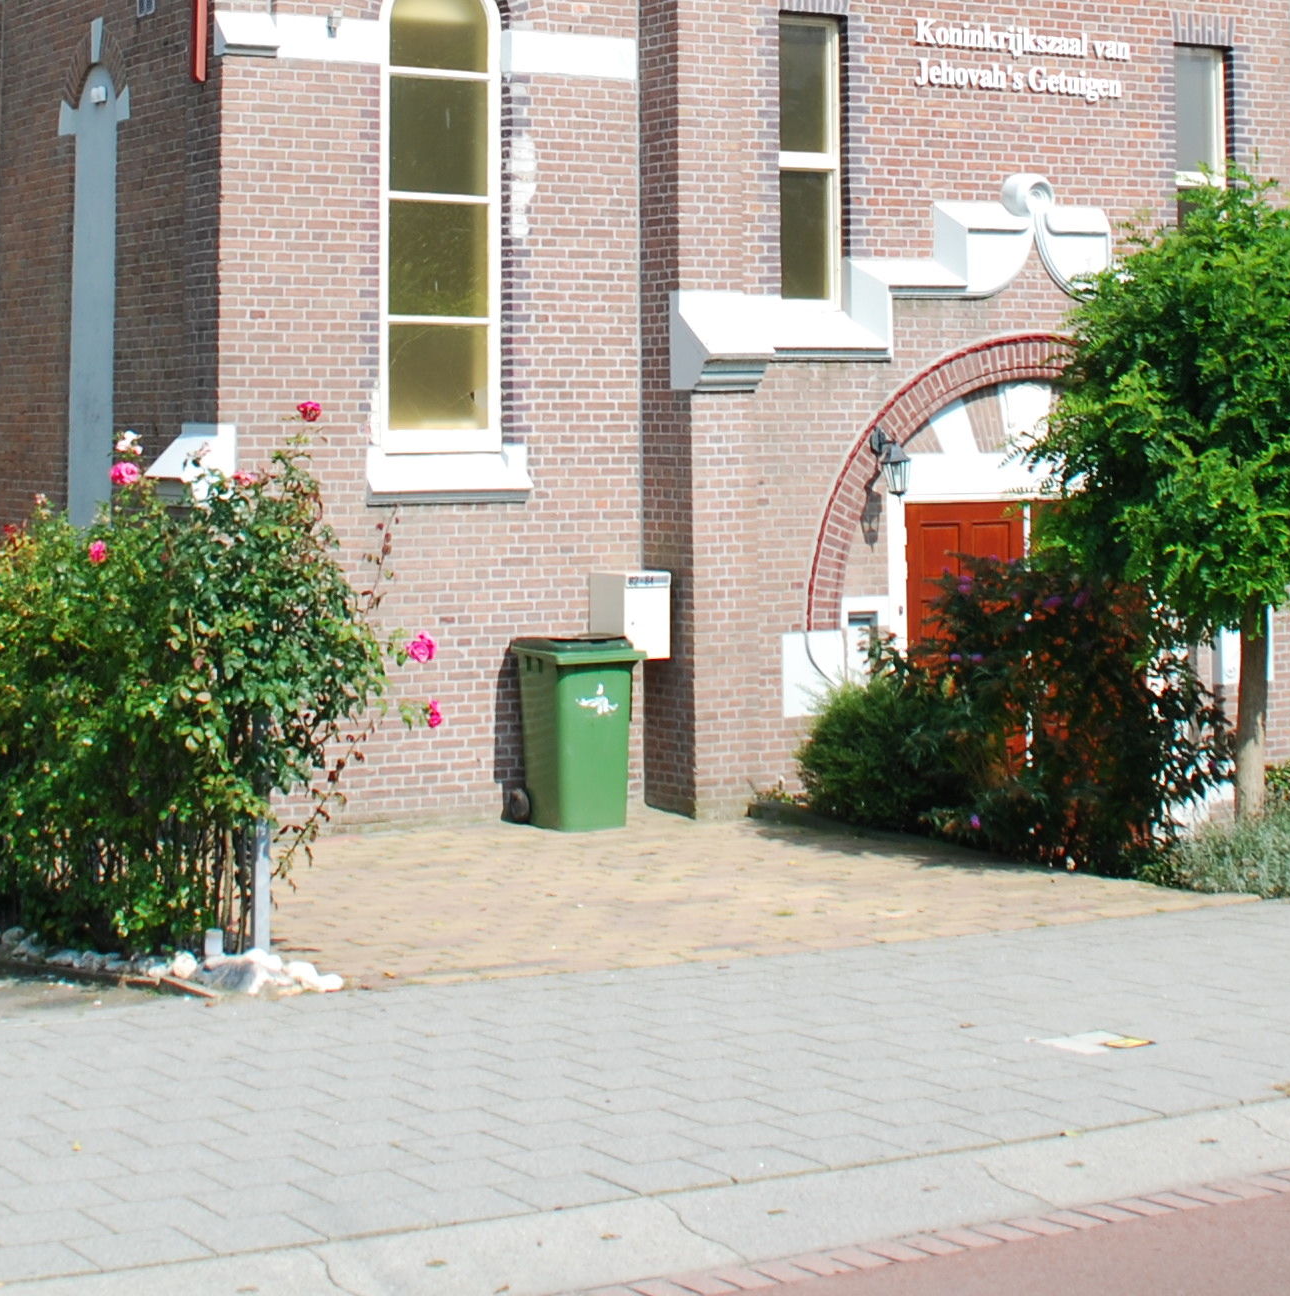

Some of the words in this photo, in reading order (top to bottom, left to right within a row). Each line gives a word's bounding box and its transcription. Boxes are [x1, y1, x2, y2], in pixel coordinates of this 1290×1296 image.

[915, 17, 1088, 57] Koninkrijkszaal
[1092, 39, 1130, 60] van
[915, 58, 1024, 90] Jehovah's
[1027, 66, 1123, 102] Getuigen
